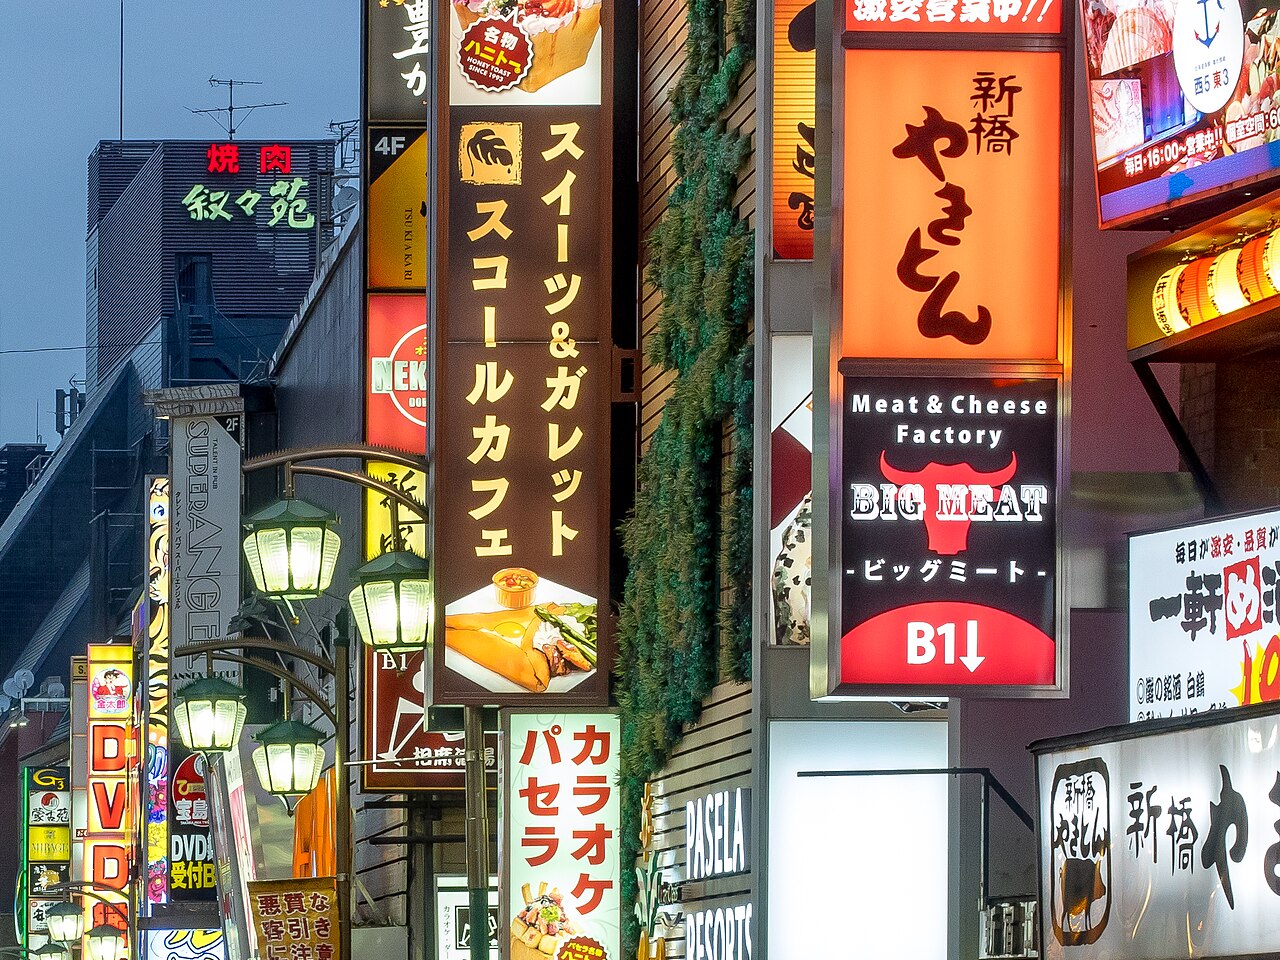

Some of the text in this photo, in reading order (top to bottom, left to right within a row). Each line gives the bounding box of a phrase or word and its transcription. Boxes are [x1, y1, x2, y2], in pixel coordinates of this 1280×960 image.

[483, 25, 520, 51] 名物
[466, 55, 490, 72] HONEY
[1193, 67, 1230, 96] 西5東3
[967, 71, 1023, 156] 新橋
[206, 144, 292, 174] 焼肉
[374, 136, 406, 156] 4F
[181, 177, 315, 229] 叙々苑
[892, 105, 993, 346] やきとん
[539, 121, 588, 557] スイーツ&ガレット
[465, 198, 515, 558] スコールカフェ
[851, 394, 1048, 415] Meat & Cheese
[225, 417, 239, 432] 2F
[896, 424, 1003, 449] Factory
[850, 483, 1049, 523] BIG MEAT
[906, 620, 956, 666] B1
[96, 699, 127, 709] 金太郎
[175, 797, 208, 821] 宝島
[519, 724, 562, 867] パセラ
[1065, 773, 1097, 813] 新橋
[571, 724, 613, 916] カラオケ
[686, 787, 745, 880] PASELA
[1125, 780, 1199, 877] 新橋
[258, 892, 330, 916] 悪質な
[261, 916, 332, 941] 客引き
